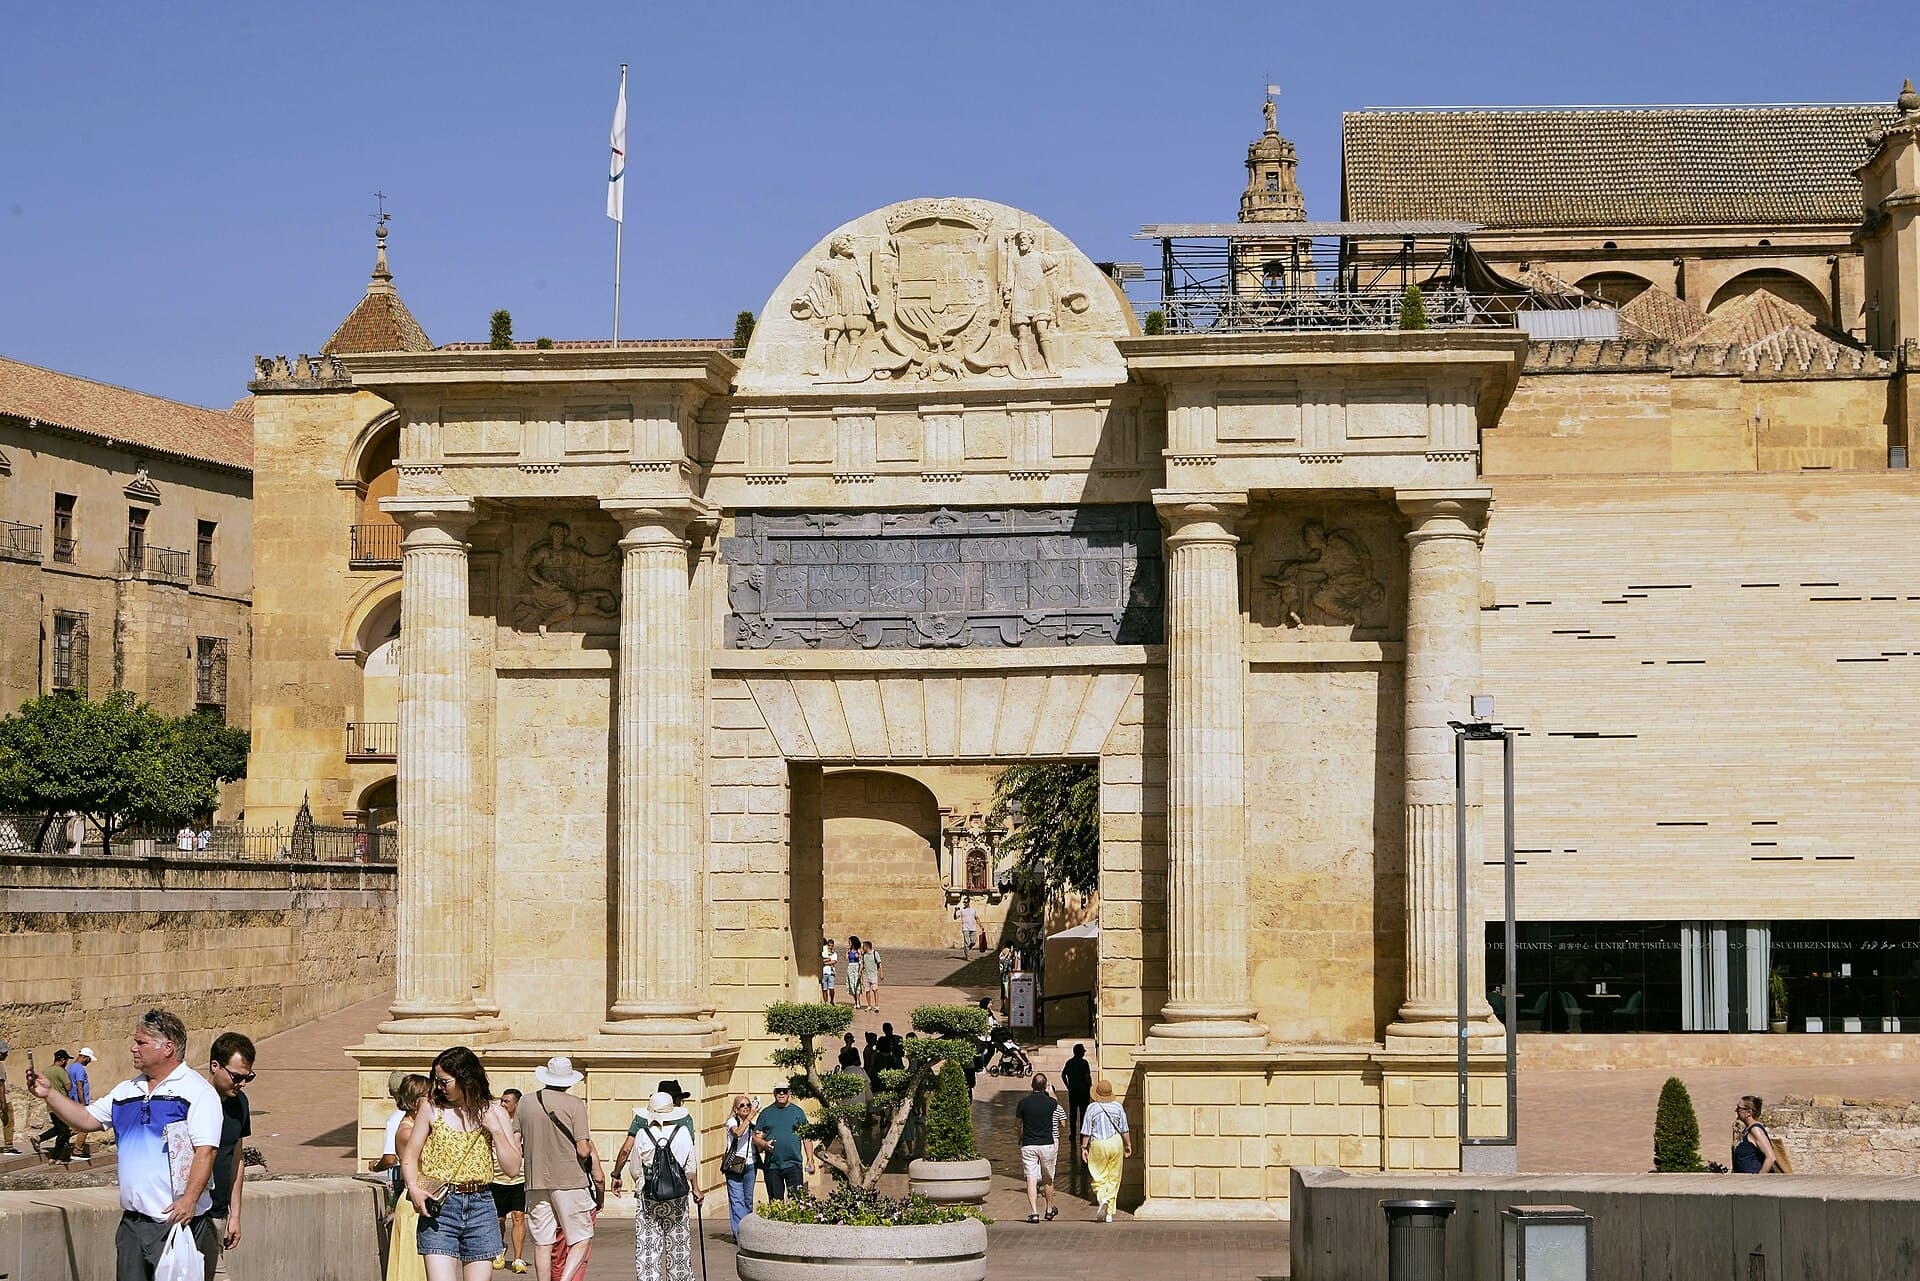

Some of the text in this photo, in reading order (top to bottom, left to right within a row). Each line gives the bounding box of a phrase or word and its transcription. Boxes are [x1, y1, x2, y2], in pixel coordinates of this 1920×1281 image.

[1493, 942, 1505, 950] DE
[1514, 942, 1553, 950] SITANTES
[1594, 942, 1627, 950] CENTRE
[1628, 942, 1640, 950] DE
[1770, 941, 1853, 950] ESUCHERZENTRUM
